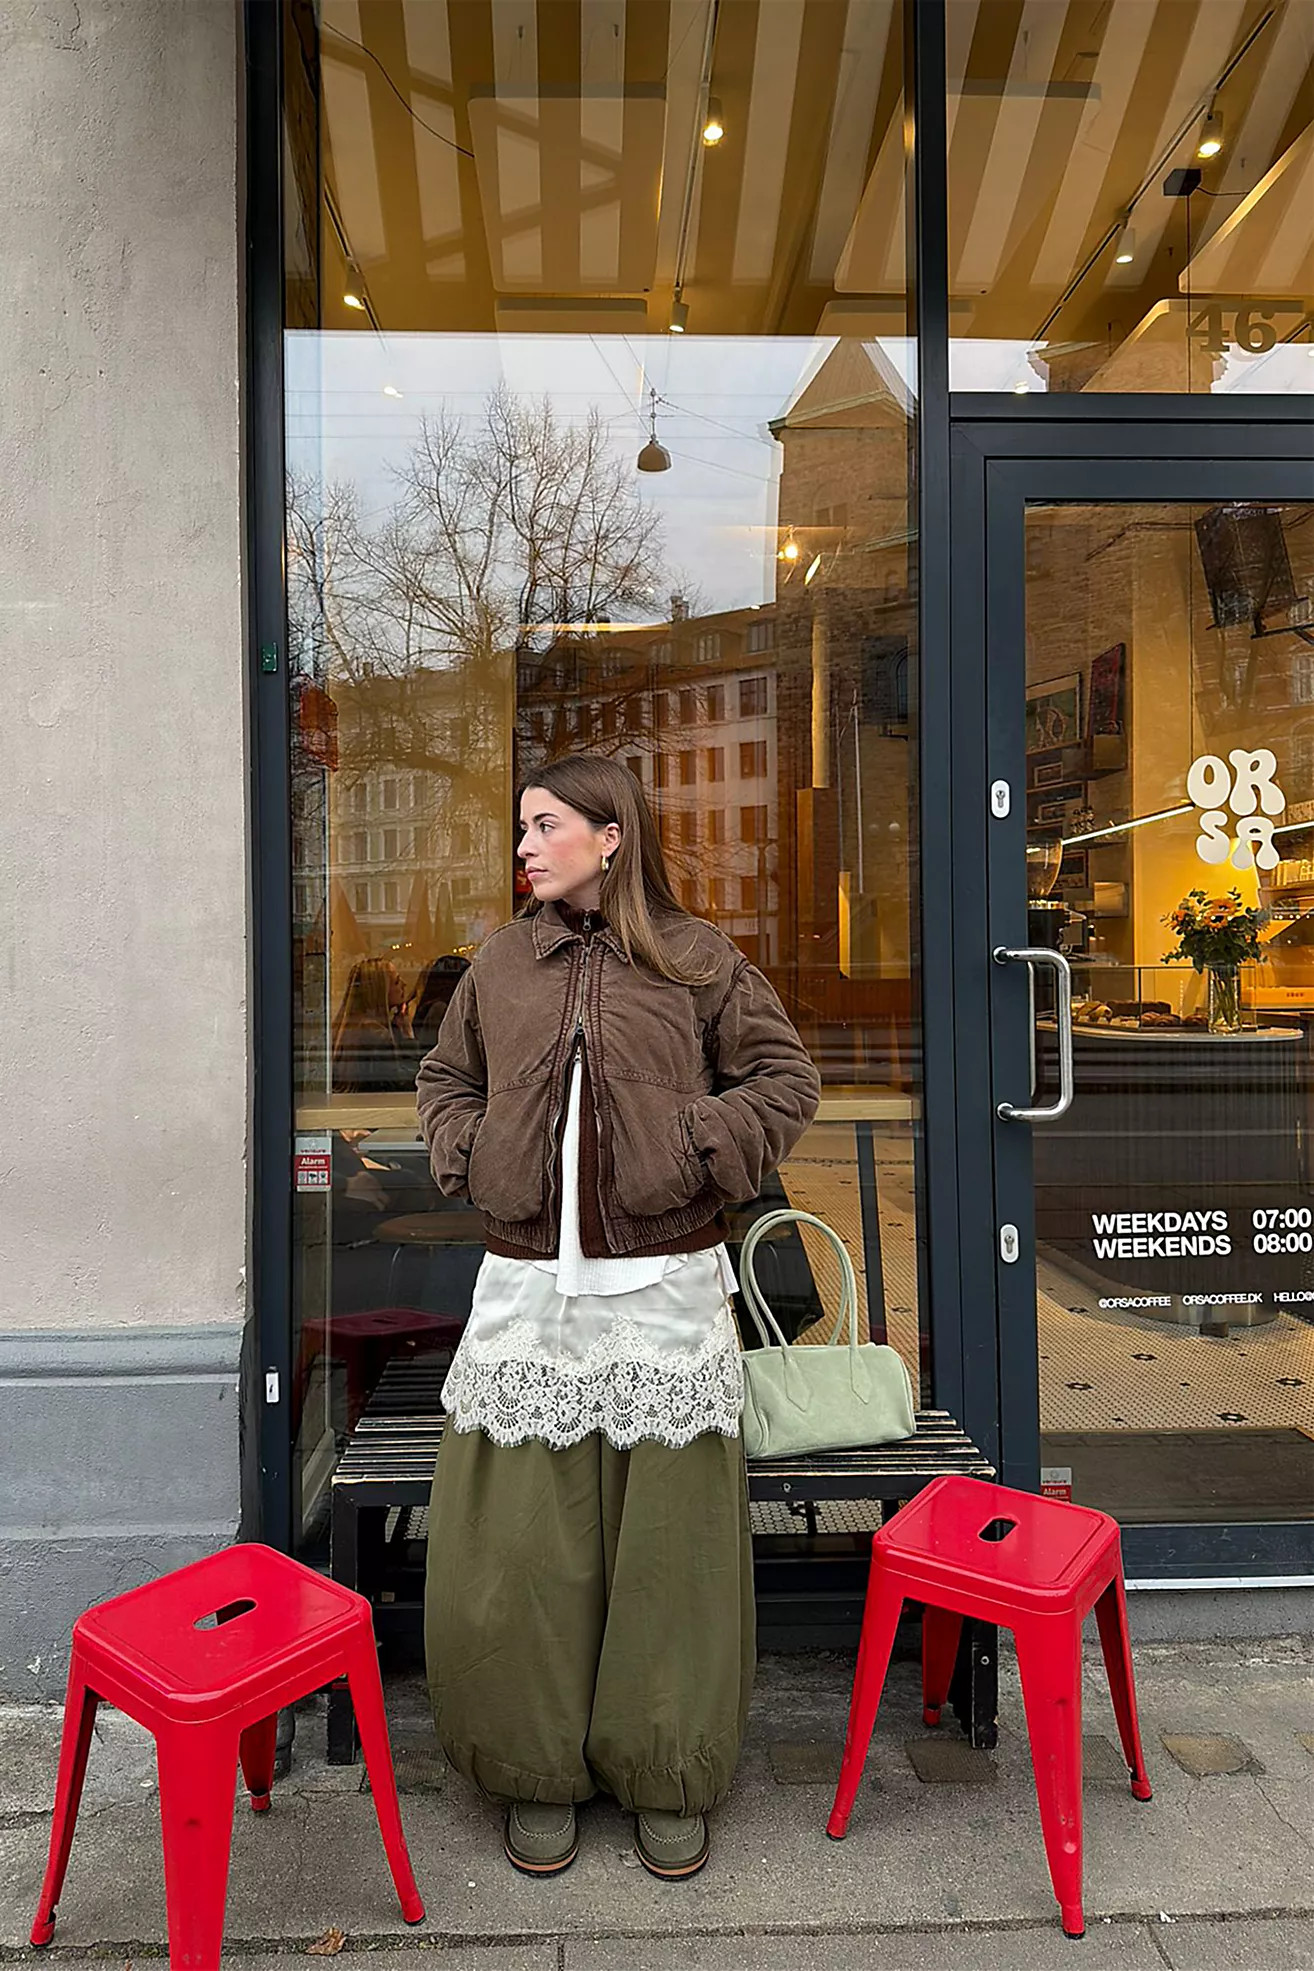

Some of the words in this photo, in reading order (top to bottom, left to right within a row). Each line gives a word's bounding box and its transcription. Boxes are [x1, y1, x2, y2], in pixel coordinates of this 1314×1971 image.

[1186, 301, 1277, 353] 46
[1187, 749, 1286, 816] OR
[1196, 810, 1280, 870] SA
[301, 1157, 325, 1165] Alarm
[1092, 1211, 1228, 1234] WEEKDAYS
[1252, 1208, 1312, 1230] 07:00
[1093, 1235, 1232, 1259] WEEKENDS
[1253, 1232, 1313, 1254] 08:00
[1098, 1296, 1171, 1309] @ORSACOFFEE
[1182, 1293, 1263, 1306] ORSACOFFEE.DK
